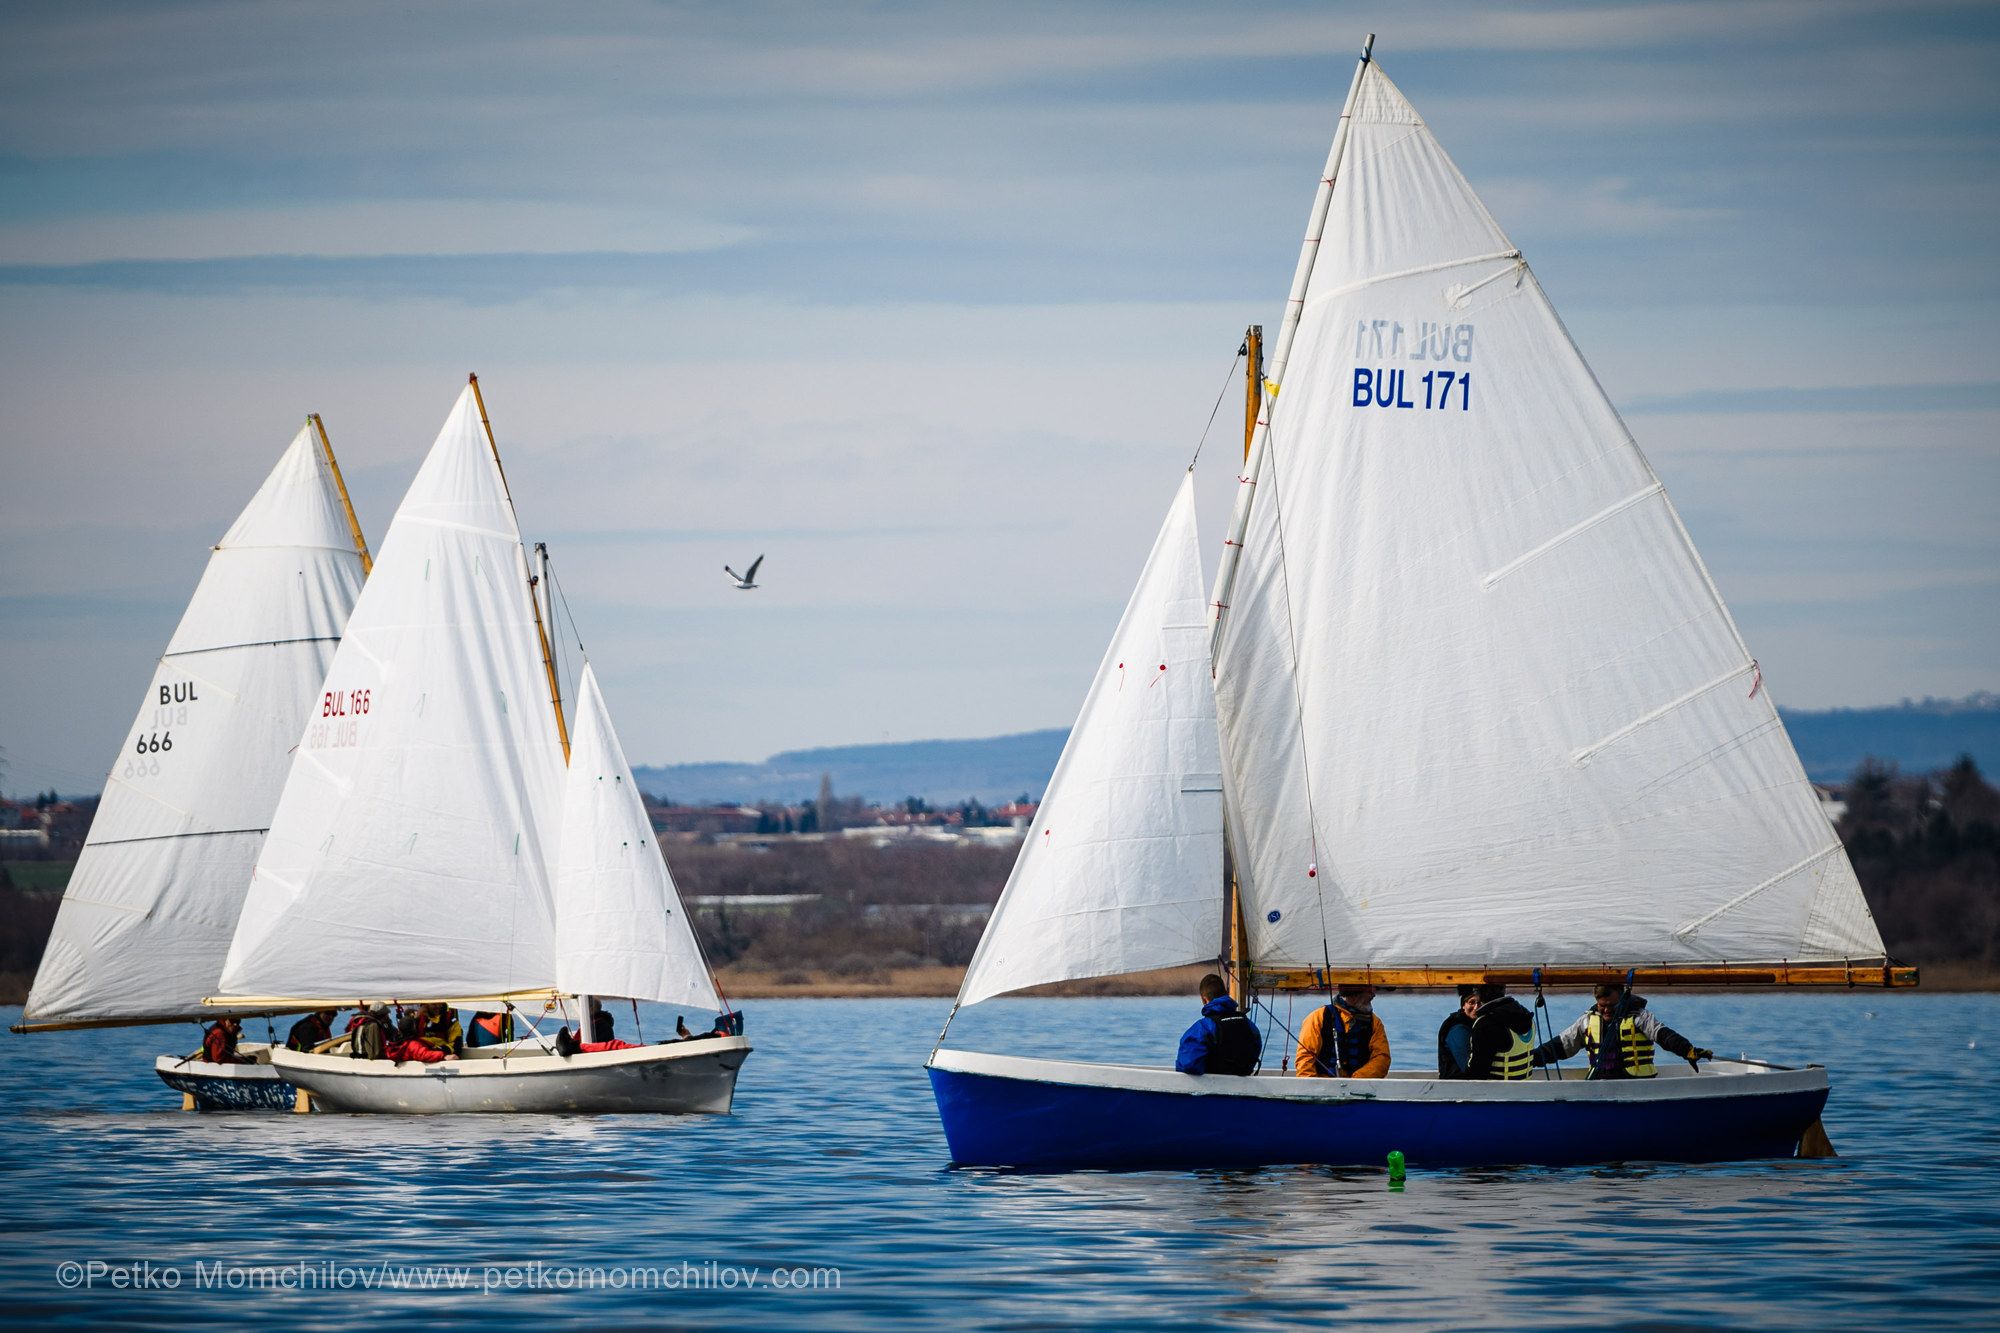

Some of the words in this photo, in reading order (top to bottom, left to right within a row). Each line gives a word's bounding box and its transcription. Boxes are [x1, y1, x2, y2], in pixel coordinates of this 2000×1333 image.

[1353, 368, 1414, 408] BUL
[1422, 370, 1470, 411] 171
[160, 681, 198, 705] BUL
[323, 692, 345, 717] BUL
[351, 689, 371, 715] 166
[136, 731, 173, 755] 666
